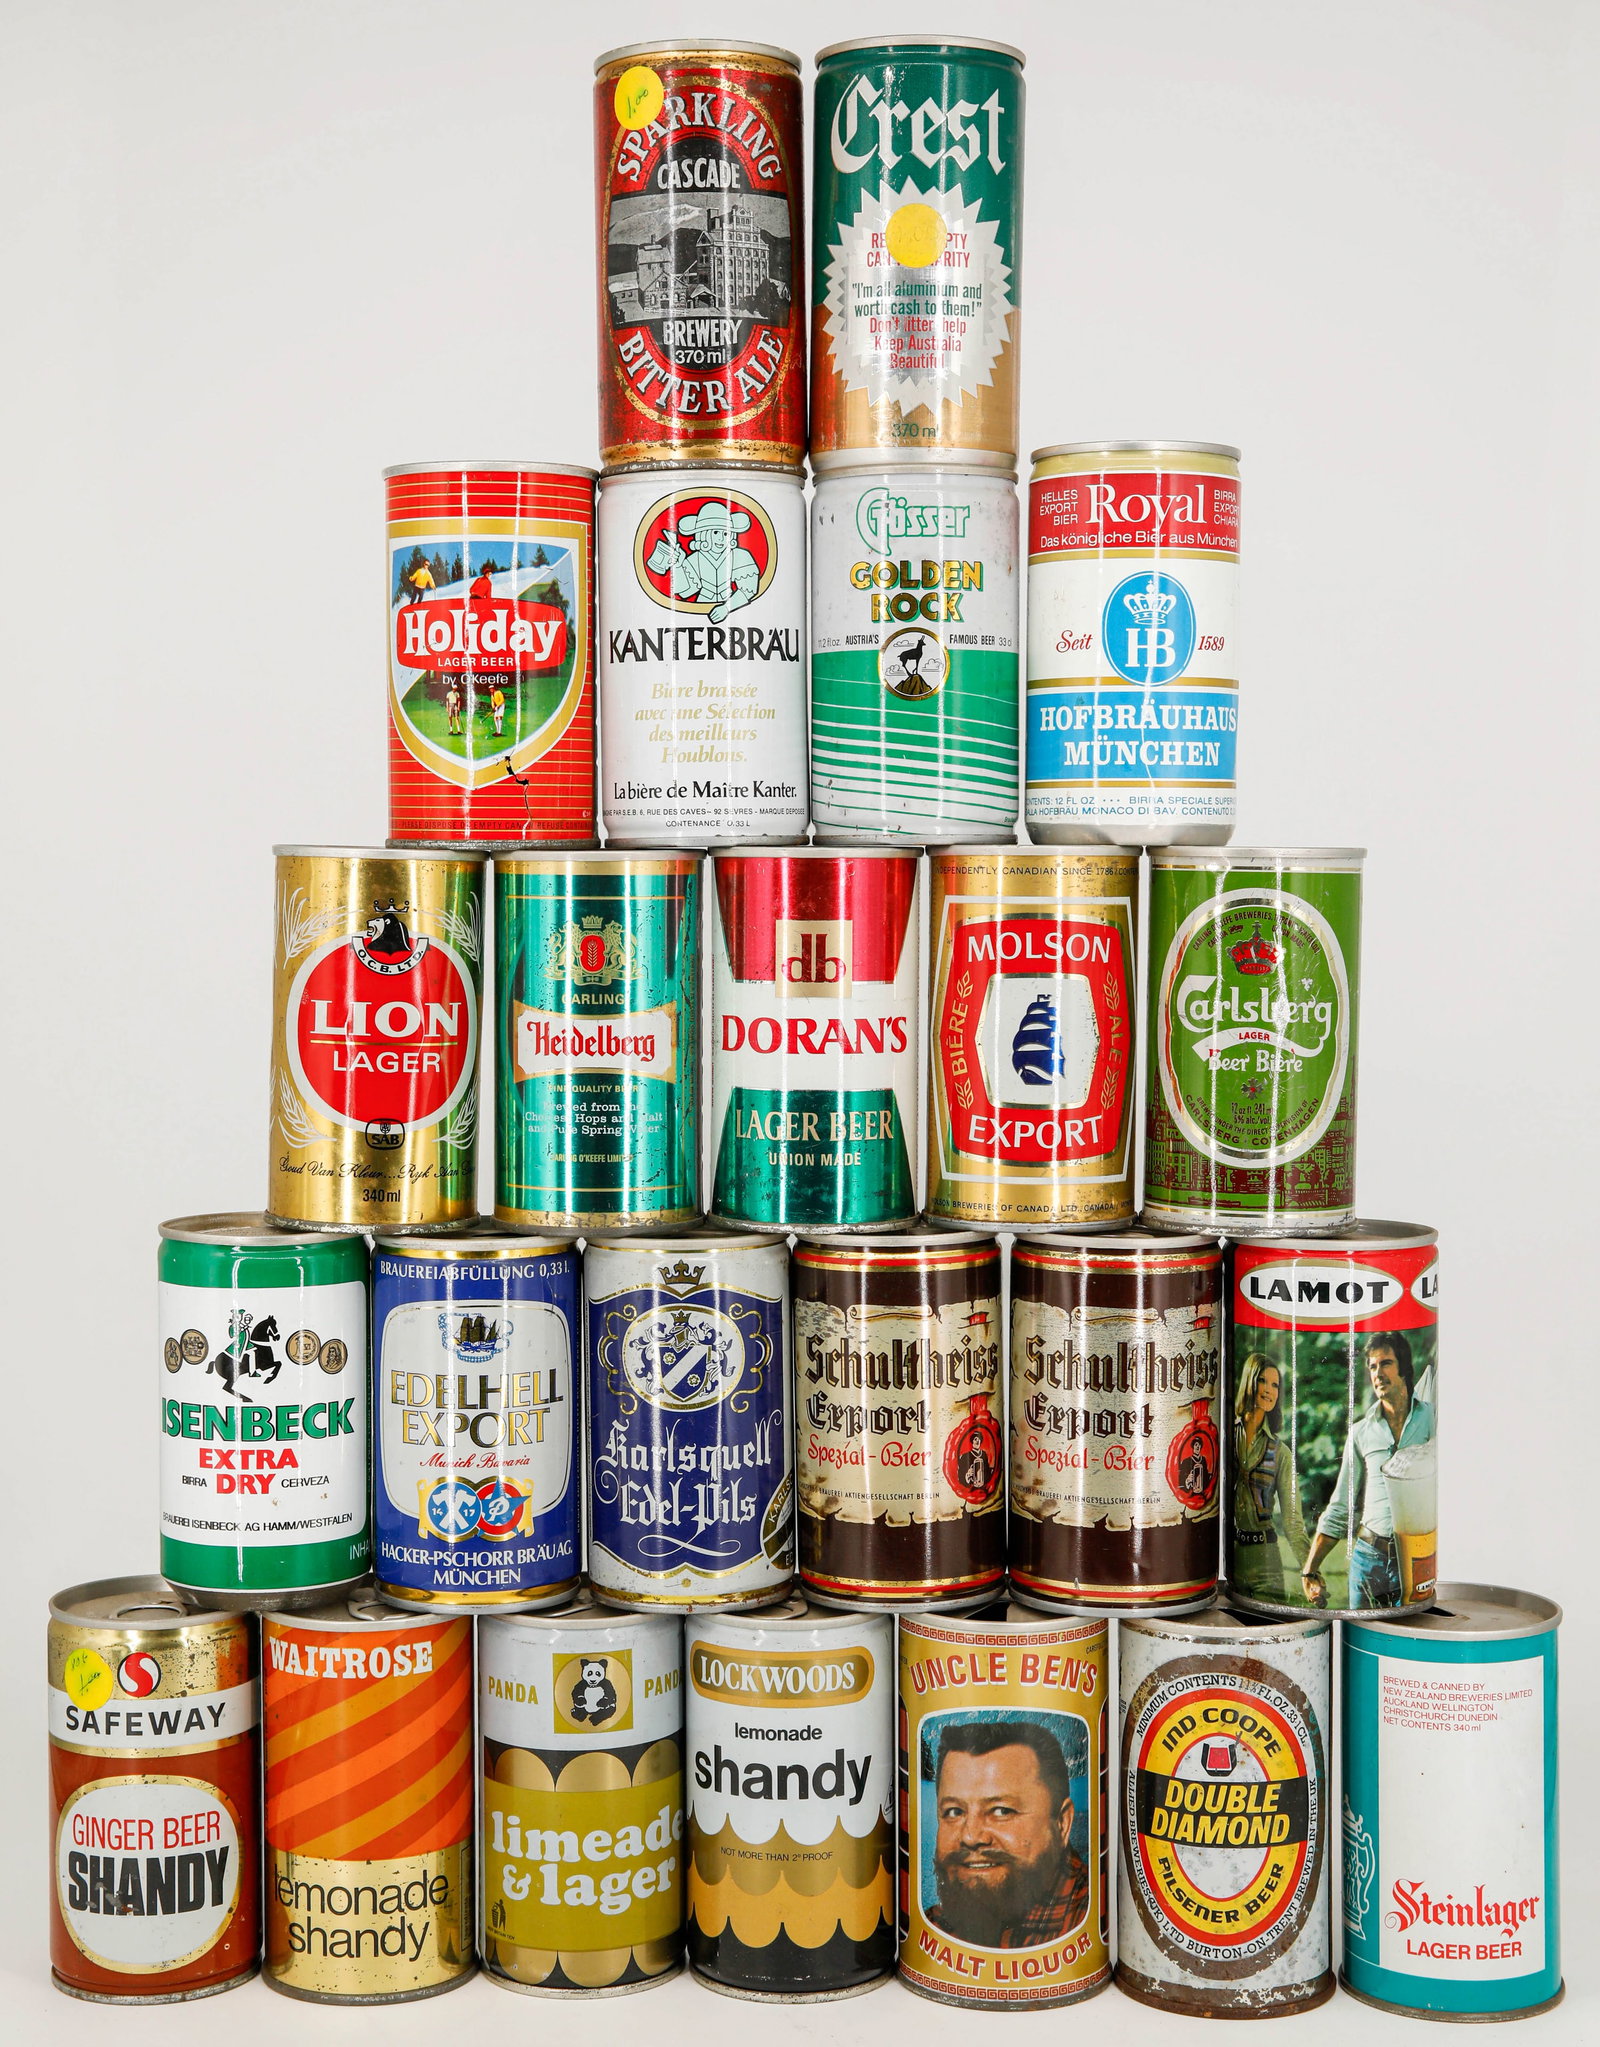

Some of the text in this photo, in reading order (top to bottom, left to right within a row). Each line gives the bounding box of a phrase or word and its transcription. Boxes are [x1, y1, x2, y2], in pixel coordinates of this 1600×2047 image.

[617, 92, 783, 182] SPARKLING
[831, 74, 1006, 175] Crest
[657, 158, 741, 190] CASCADE
[894, 280, 982, 299] aluminium and
[890, 299, 936, 315] cash to
[663, 319, 743, 348] BREWERY
[618, 330, 785, 414] BITTER ALE
[892, 424, 919, 437] 370
[1039, 502, 1078, 515] EXPORT
[1041, 489, 1078, 504] HELLES
[1085, 484, 1207, 532] Royal
[1214, 490, 1236, 502] BIRRA
[1053, 515, 1078, 526] BIER
[1040, 531, 1238, 548] Das königliche Bier aus München
[850, 561, 983, 591] GOLDEN
[871, 593, 964, 623] ROCK
[403, 610, 563, 662] Holiday
[610, 627, 799, 663] KANTERBRÄU
[845, 634, 995, 646] AUSTRIA'S FAMOUS BEER
[1056, 629, 1093, 653] Seit
[1125, 628, 1176, 668] HB
[1198, 636, 1225, 651] 1589
[438, 657, 514, 667] LAGER BEER
[442, 675, 456, 685] by
[635, 708, 666, 721] avec
[1040, 699, 1237, 732] HOFBRÄUHAUS
[650, 724, 673, 742] des
[1064, 735, 1220, 766] MÜNCHEN
[614, 780, 797, 799] La bière de Maître Kanter.
[1168, 797, 1212, 805] SPECIALE
[1082, 807, 1134, 815] MONACO
[1003, 867, 1092, 875] CANADIAN SINCE
[781, 933, 846, 983] db
[968, 932, 1110, 964] MOLSON
[562, 994, 625, 1004] CARLING
[1177, 975, 1332, 1040] Carlsberg
[310, 1000, 461, 1038] LION
[527, 1021, 655, 1062] Heidelberg
[722, 1015, 907, 1054] DORAN'S
[945, 997, 969, 1076] BIÈRE
[1109, 1016, 1123, 1065] ALE
[1239, 1032, 1270, 1041] LAGER
[333, 1051, 440, 1073] LAGER
[1208, 1049, 1250, 1072] Beer
[573, 1085, 612, 1093] QUALITY
[575, 1115, 607, 1125] Hops
[591, 1102, 620, 1112] from
[372, 1134, 399, 1145] SAB
[582, 1126, 622, 1137] Spring
[736, 1109, 894, 1142] LAGER BEER
[969, 1115, 1103, 1149] EXPORT
[308, 1161, 335, 1177] Van
[579, 1154, 606, 1163] O'KEEFE
[769, 1152, 861, 1166] UNION MADE
[363, 1189, 384, 1201] 340
[380, 1260, 535, 1281] BRAUEREIABFÜLLUNG
[1250, 1277, 1389, 1304] LAMOT
[805, 1334, 998, 1390] Schultheiss
[1024, 1334, 1218, 1393] Schultheiss
[391, 1369, 564, 1410] EDELHELL
[161, 1397, 356, 1442] ISENBECK
[403, 1408, 550, 1448] EXPORT
[806, 1390, 932, 1438] Export
[1024, 1391, 1154, 1440] Export
[200, 1448, 299, 1470] EXTRA
[594, 1409, 782, 1488] Karlsquell
[182, 1476, 207, 1487] BIRRA
[216, 1474, 276, 1495] DRY
[281, 1476, 329, 1488] CERVEZA
[463, 1509, 475, 1517] 17
[620, 1475, 757, 1535] Edel-Pils
[192, 1513, 352, 1532] ISENBECK AG HAMM/WESTFALEN
[381, 1542, 556, 1567] HACKER-PSCHORR BRÄU
[433, 1568, 521, 1585] MÜNCHEN
[269, 1636, 433, 1679] WAITROSE
[700, 1655, 855, 1694] LOCKWOODS
[909, 1653, 1098, 1697] UNCLE BEN'S
[1383, 1676, 1420, 1689] BREWED
[1431, 1682, 1470, 1691] CANNED
[1473, 1683, 1485, 1691] BY
[488, 1676, 539, 1705] PANDA
[1383, 1686, 1532, 1701] NEW ZEALAND BREWERIES LIMITED
[1383, 1697, 1494, 1712] AUCKLAND WELLINGTON
[66, 1702, 225, 1736] SAFEWAY
[1136, 1690, 1169, 1739] MINIMUM
[1168, 1674, 1237, 1696] CONTENTS
[1383, 1707, 1498, 1721] CHRISTCHURCH DUNEDIN
[735, 1722, 823, 1741] lemonade
[1162, 1708, 1282, 1758] IND COOPE
[1383, 1716, 1398, 1726] NET
[1401, 1720, 1451, 1731] CONTENTS
[695, 1744, 872, 1806] shandy
[1310, 1778, 1316, 1797] UK
[1164, 1779, 1281, 1814] DOUBLE
[73, 1810, 221, 1850] GINGER BEER
[1150, 1808, 1290, 1846] DIAMOND
[1310, 1828, 1315, 1841] IN
[721, 1847, 833, 1861] NOT MORE THAN PROOF
[68, 1845, 230, 1916] SHANDY
[502, 1856, 676, 1915] & lager
[1295, 1845, 1314, 1903] BREWED
[274, 1864, 449, 1915] lemonade
[1159, 1856, 1284, 1924] PILSENER BEER
[1384, 1878, 1540, 1938] Steinlager
[288, 1915, 430, 1962] shandy
[1163, 1902, 1299, 1959] LTD BURTON-ON-TRENT
[918, 1929, 1093, 1983] MALT LIQUOR
[1407, 1939, 1522, 1960] LAGER BEER
